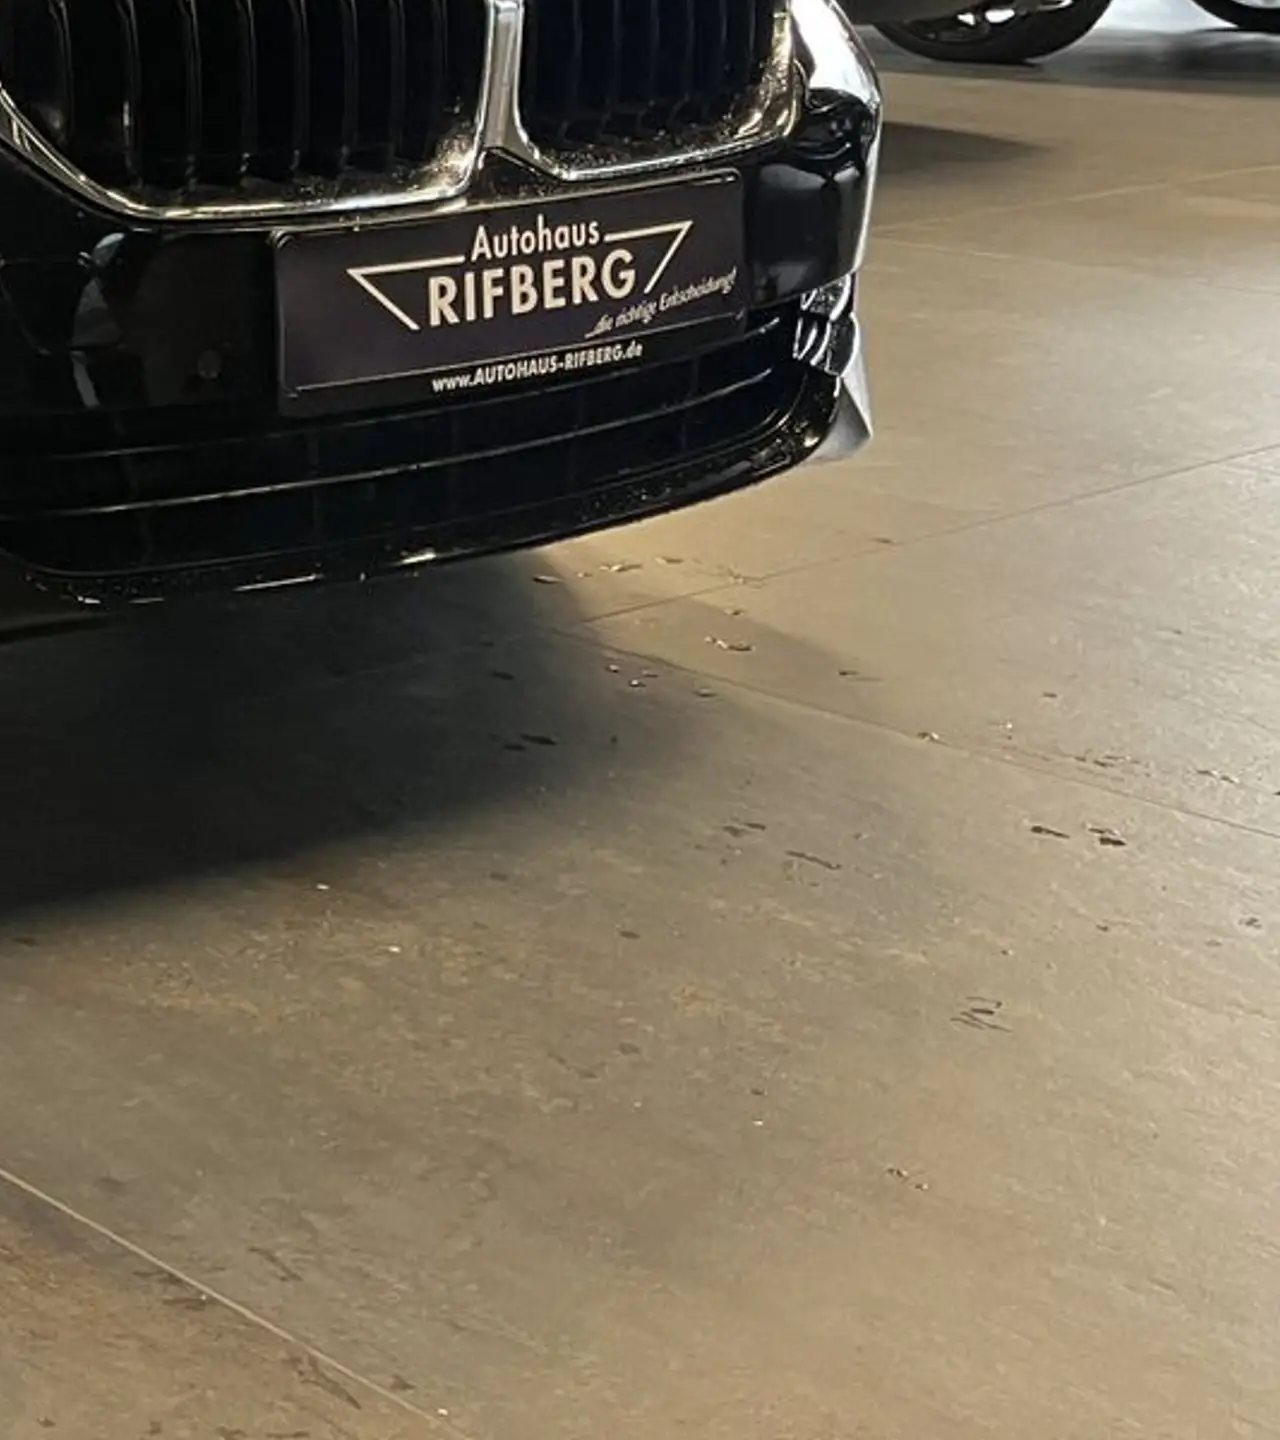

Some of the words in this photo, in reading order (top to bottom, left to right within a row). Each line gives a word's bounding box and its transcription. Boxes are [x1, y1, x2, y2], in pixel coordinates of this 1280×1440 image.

[471, 213, 601, 262] Autohaus
[428, 248, 637, 327] RIFBERG
[431, 339, 644, 393] www.AUTOHAUS-RIFBERG.de
